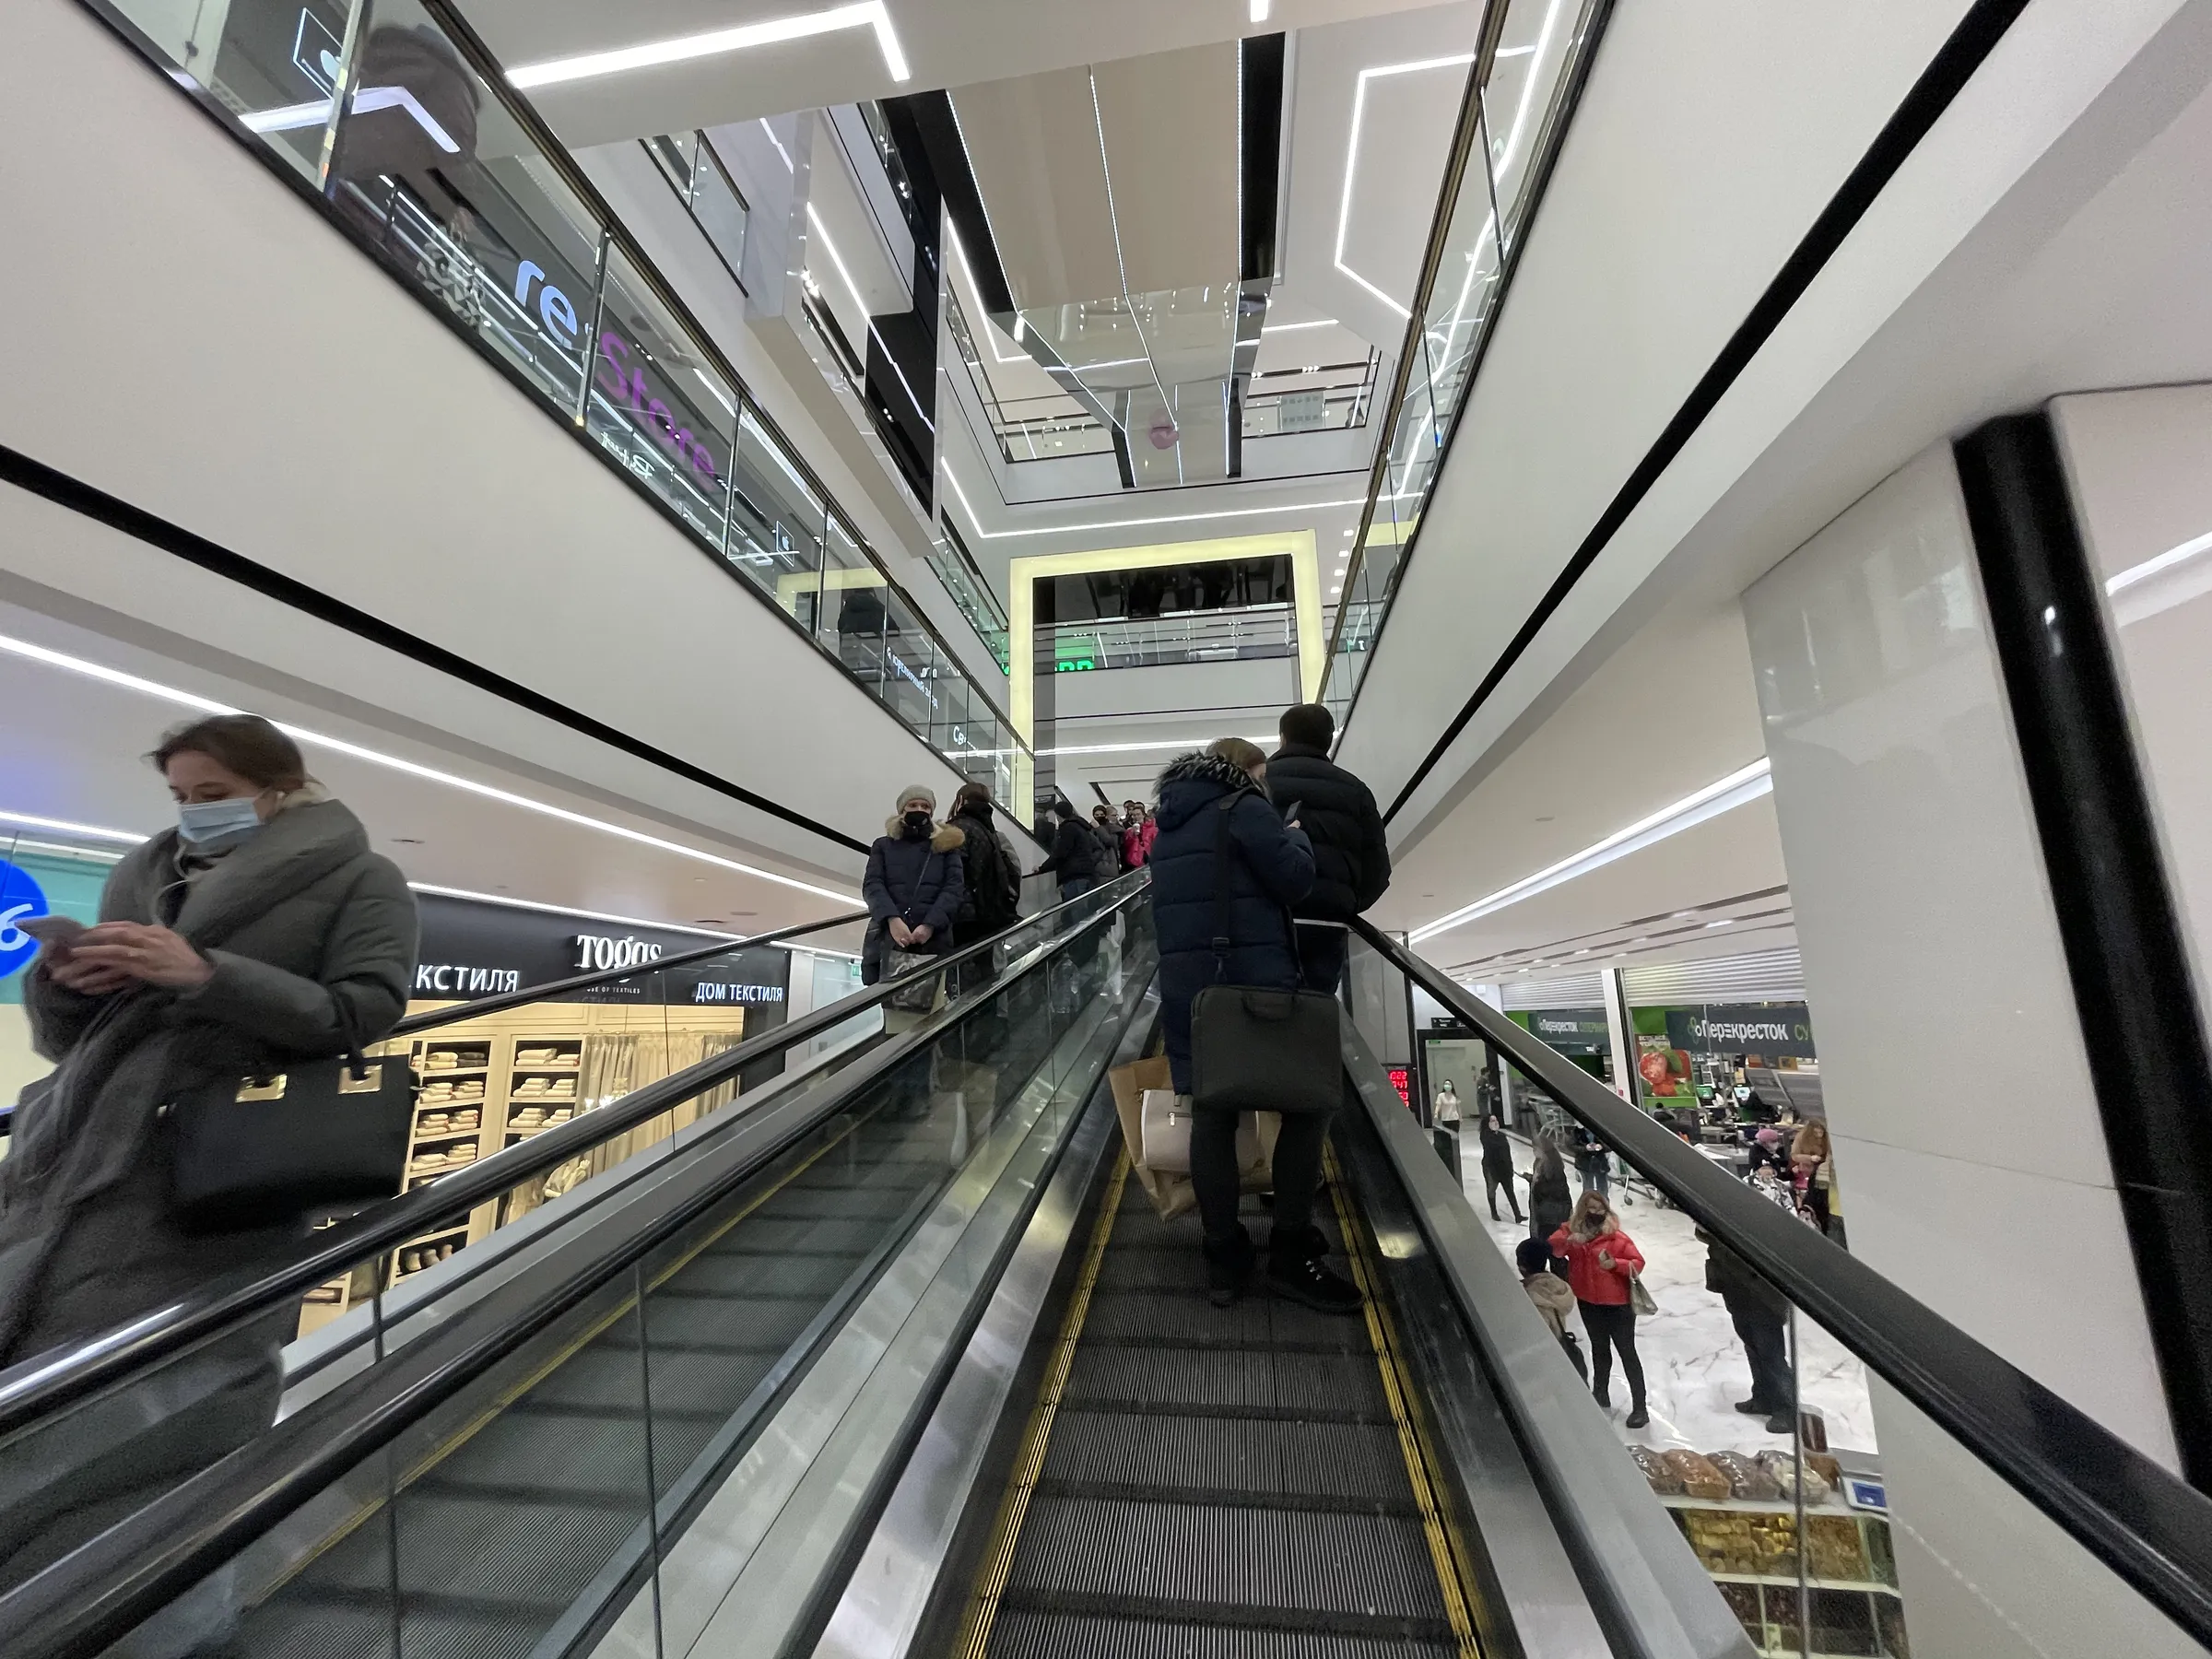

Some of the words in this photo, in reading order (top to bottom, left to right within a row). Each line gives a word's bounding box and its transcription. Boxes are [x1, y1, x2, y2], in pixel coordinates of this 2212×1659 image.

[416, 964, 519, 992] КСТИЛЯ
[696, 982, 726, 1003] ДОМ
[729, 984, 782, 1003] ТЕКСТИЛЯ
[1701, 1019, 1789, 1044] Перекресток
